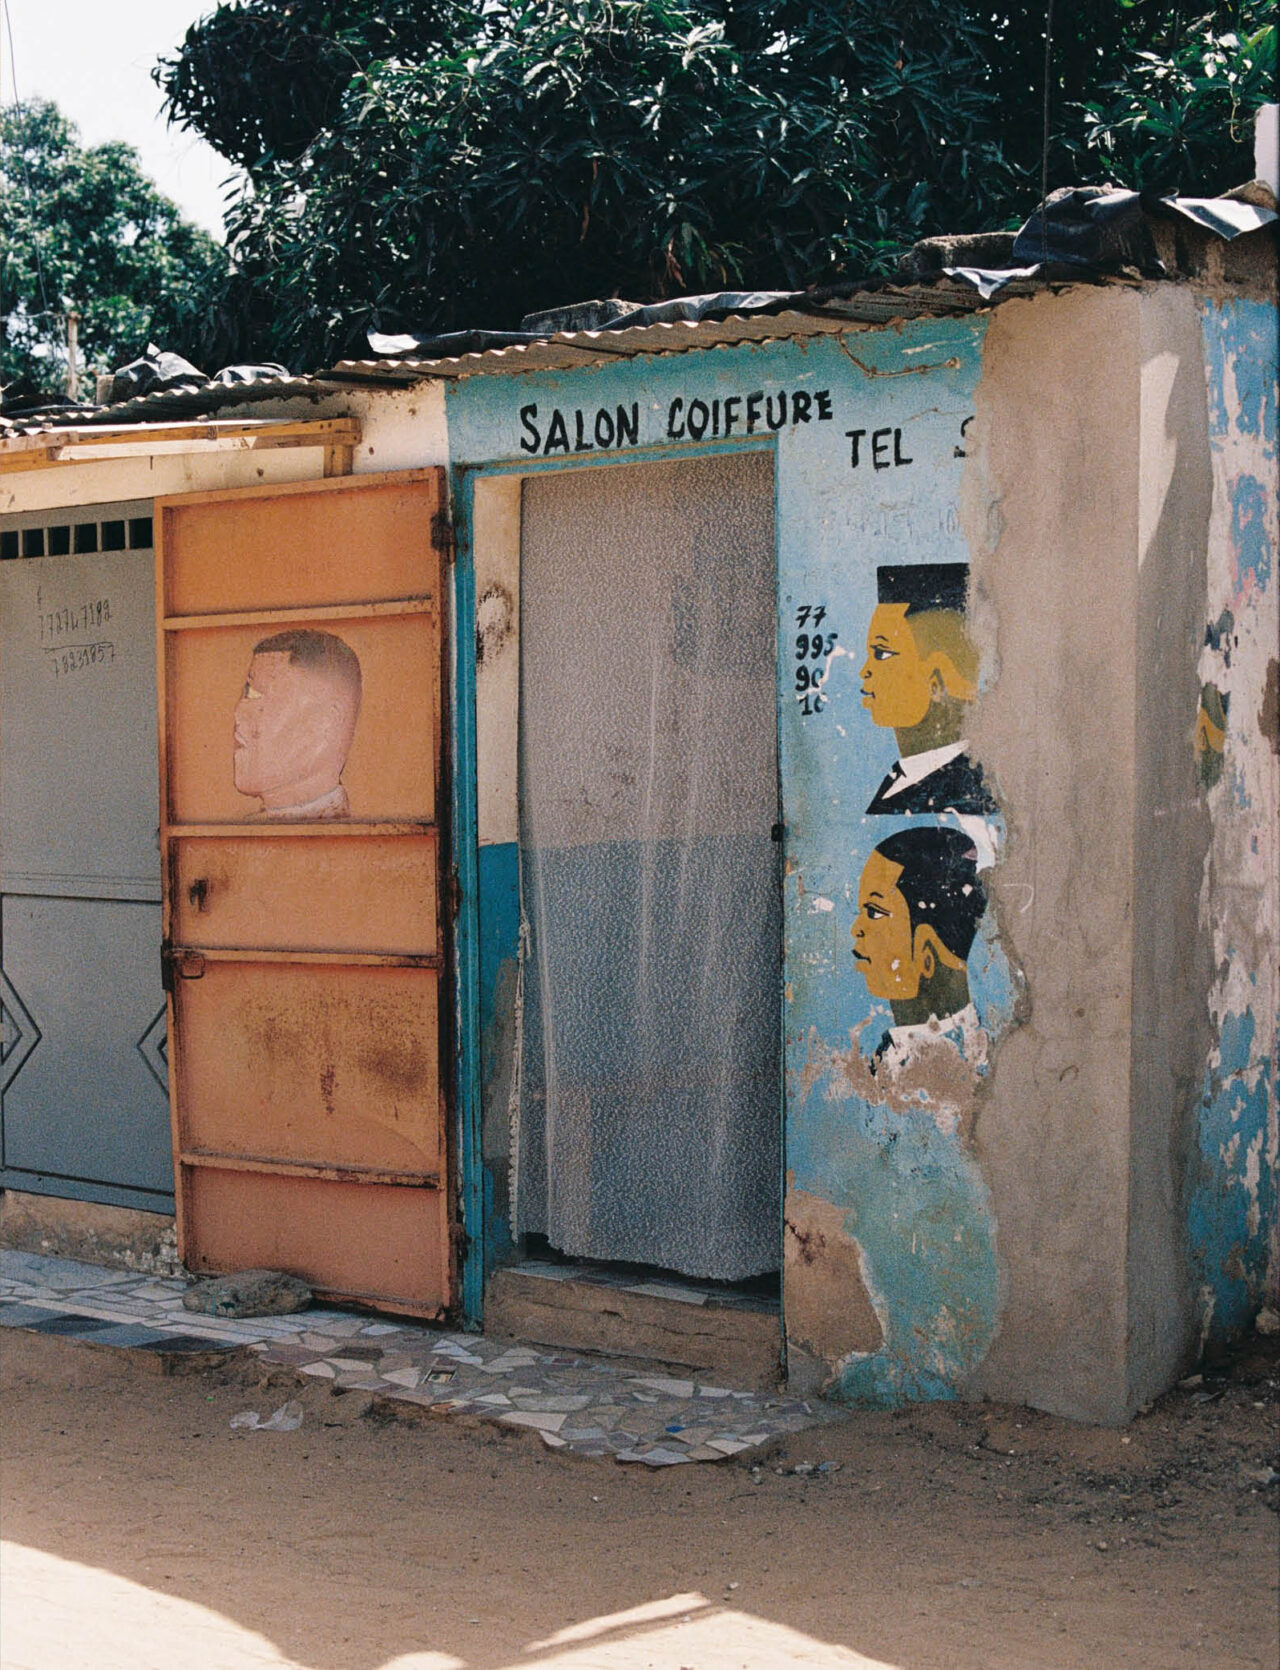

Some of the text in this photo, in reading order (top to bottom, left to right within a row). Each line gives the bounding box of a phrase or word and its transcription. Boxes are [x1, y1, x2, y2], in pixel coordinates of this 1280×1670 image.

[519, 389, 834, 456] SALON COIFFURE
[845, 427, 913, 473] TEL
[795, 605, 827, 629] 77
[795, 633, 838, 660] 995
